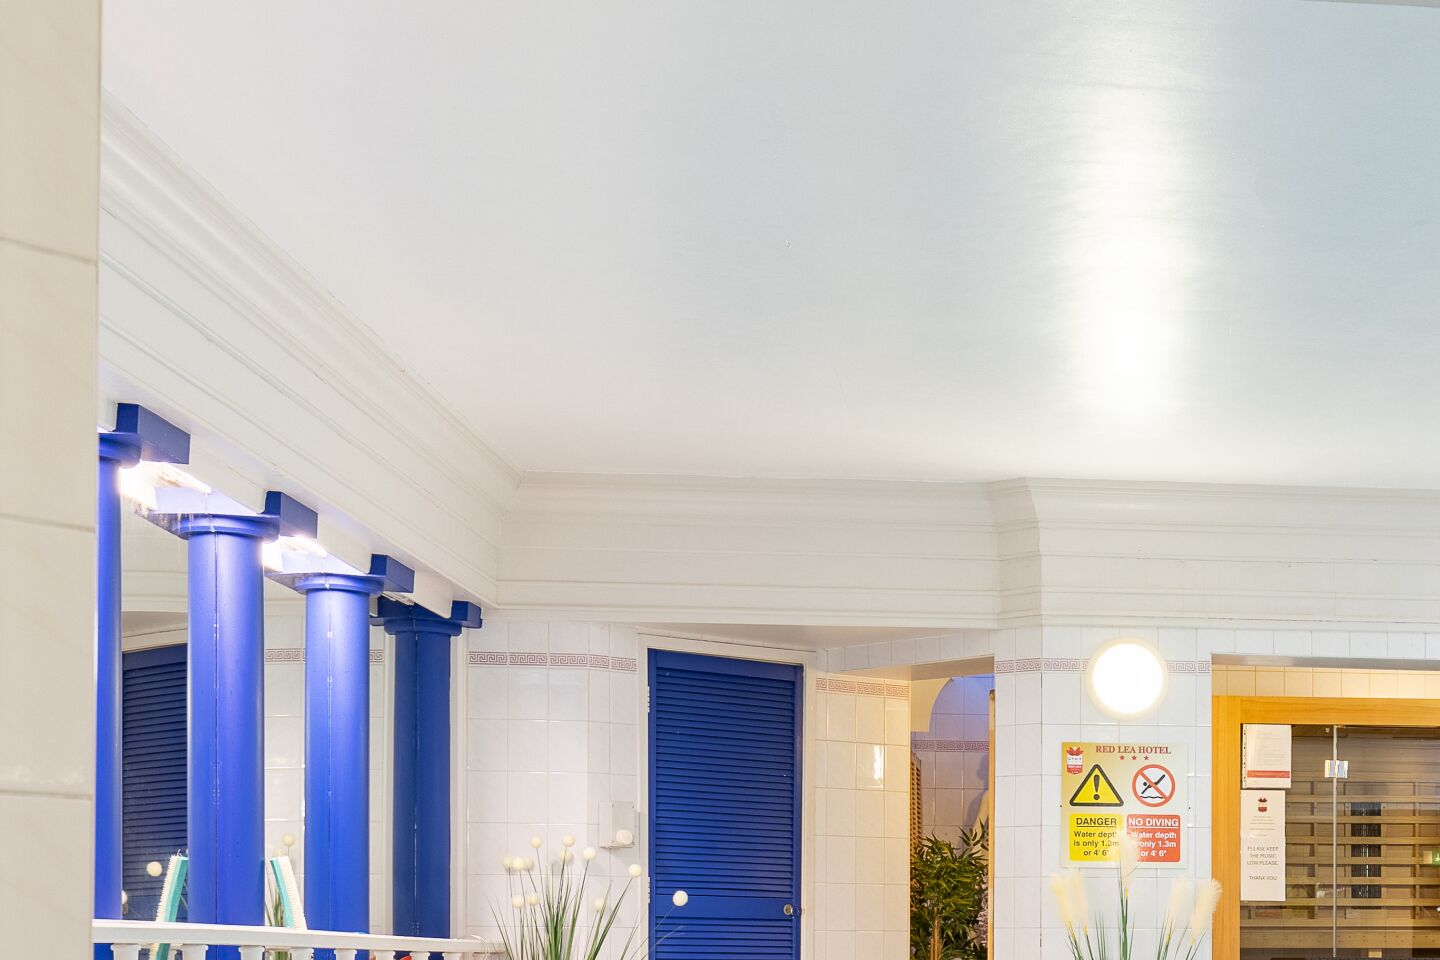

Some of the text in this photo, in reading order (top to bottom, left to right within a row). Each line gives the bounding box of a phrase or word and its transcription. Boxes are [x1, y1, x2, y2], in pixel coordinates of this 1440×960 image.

[1095, 745, 1172, 755] RED LEA HOTEL
[1076, 817, 1117, 826] DANGER
[1128, 818, 1179, 827] NO DIVING
[1073, 830, 1096, 838] Water
[1154, 831, 1177, 840] depth
[1082, 840, 1099, 848] only
[1157, 840, 1177, 848] 1.3m
